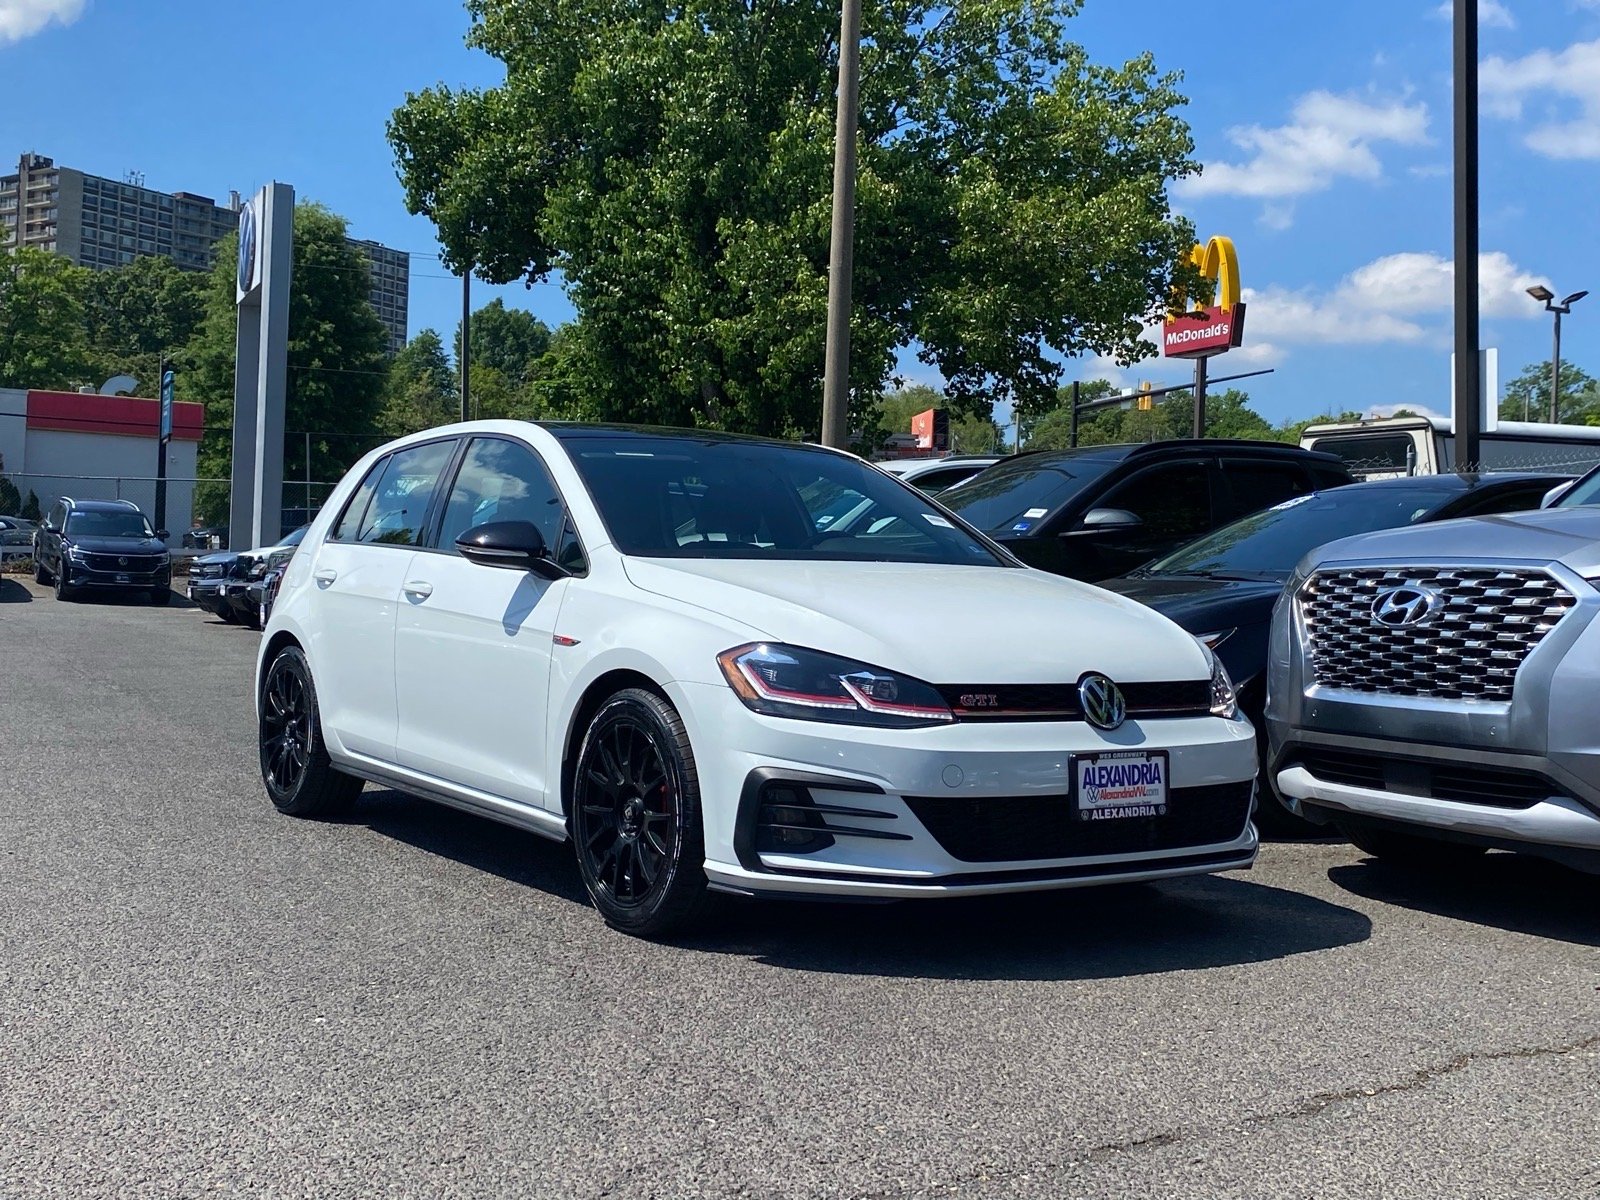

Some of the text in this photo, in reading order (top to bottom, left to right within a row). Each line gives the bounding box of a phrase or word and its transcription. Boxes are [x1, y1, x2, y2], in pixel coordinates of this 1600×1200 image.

[1166, 323, 1229, 345] McDonald's
[960, 694, 998, 707] GTI
[1083, 763, 1161, 789] ALEXANDRIA
[1092, 806, 1156, 820] ALEXANDRIA
